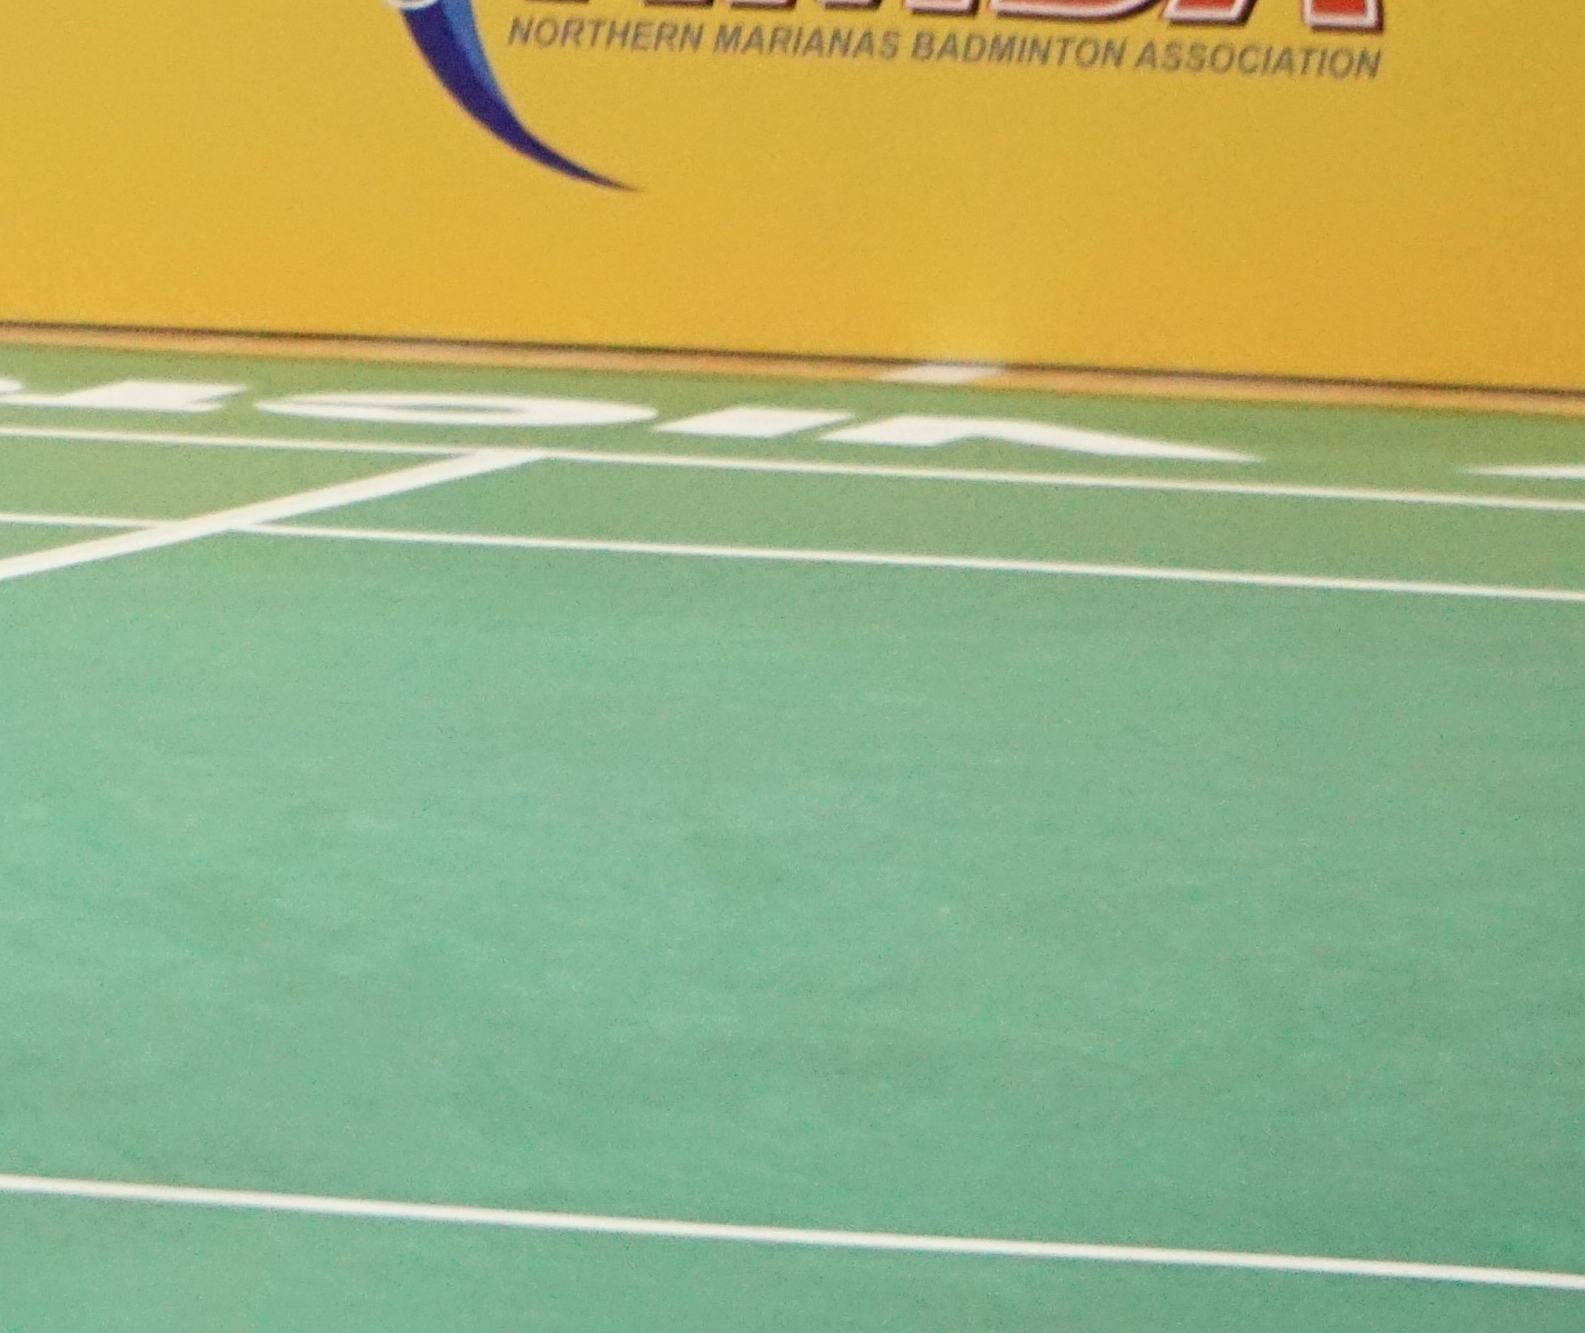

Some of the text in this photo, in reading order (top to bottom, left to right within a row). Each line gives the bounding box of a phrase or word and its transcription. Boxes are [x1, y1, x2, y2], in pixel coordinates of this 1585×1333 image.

[506, 15, 1383, 81] NORTHERN MARIANAS BADMINTON ASSOCIATION
